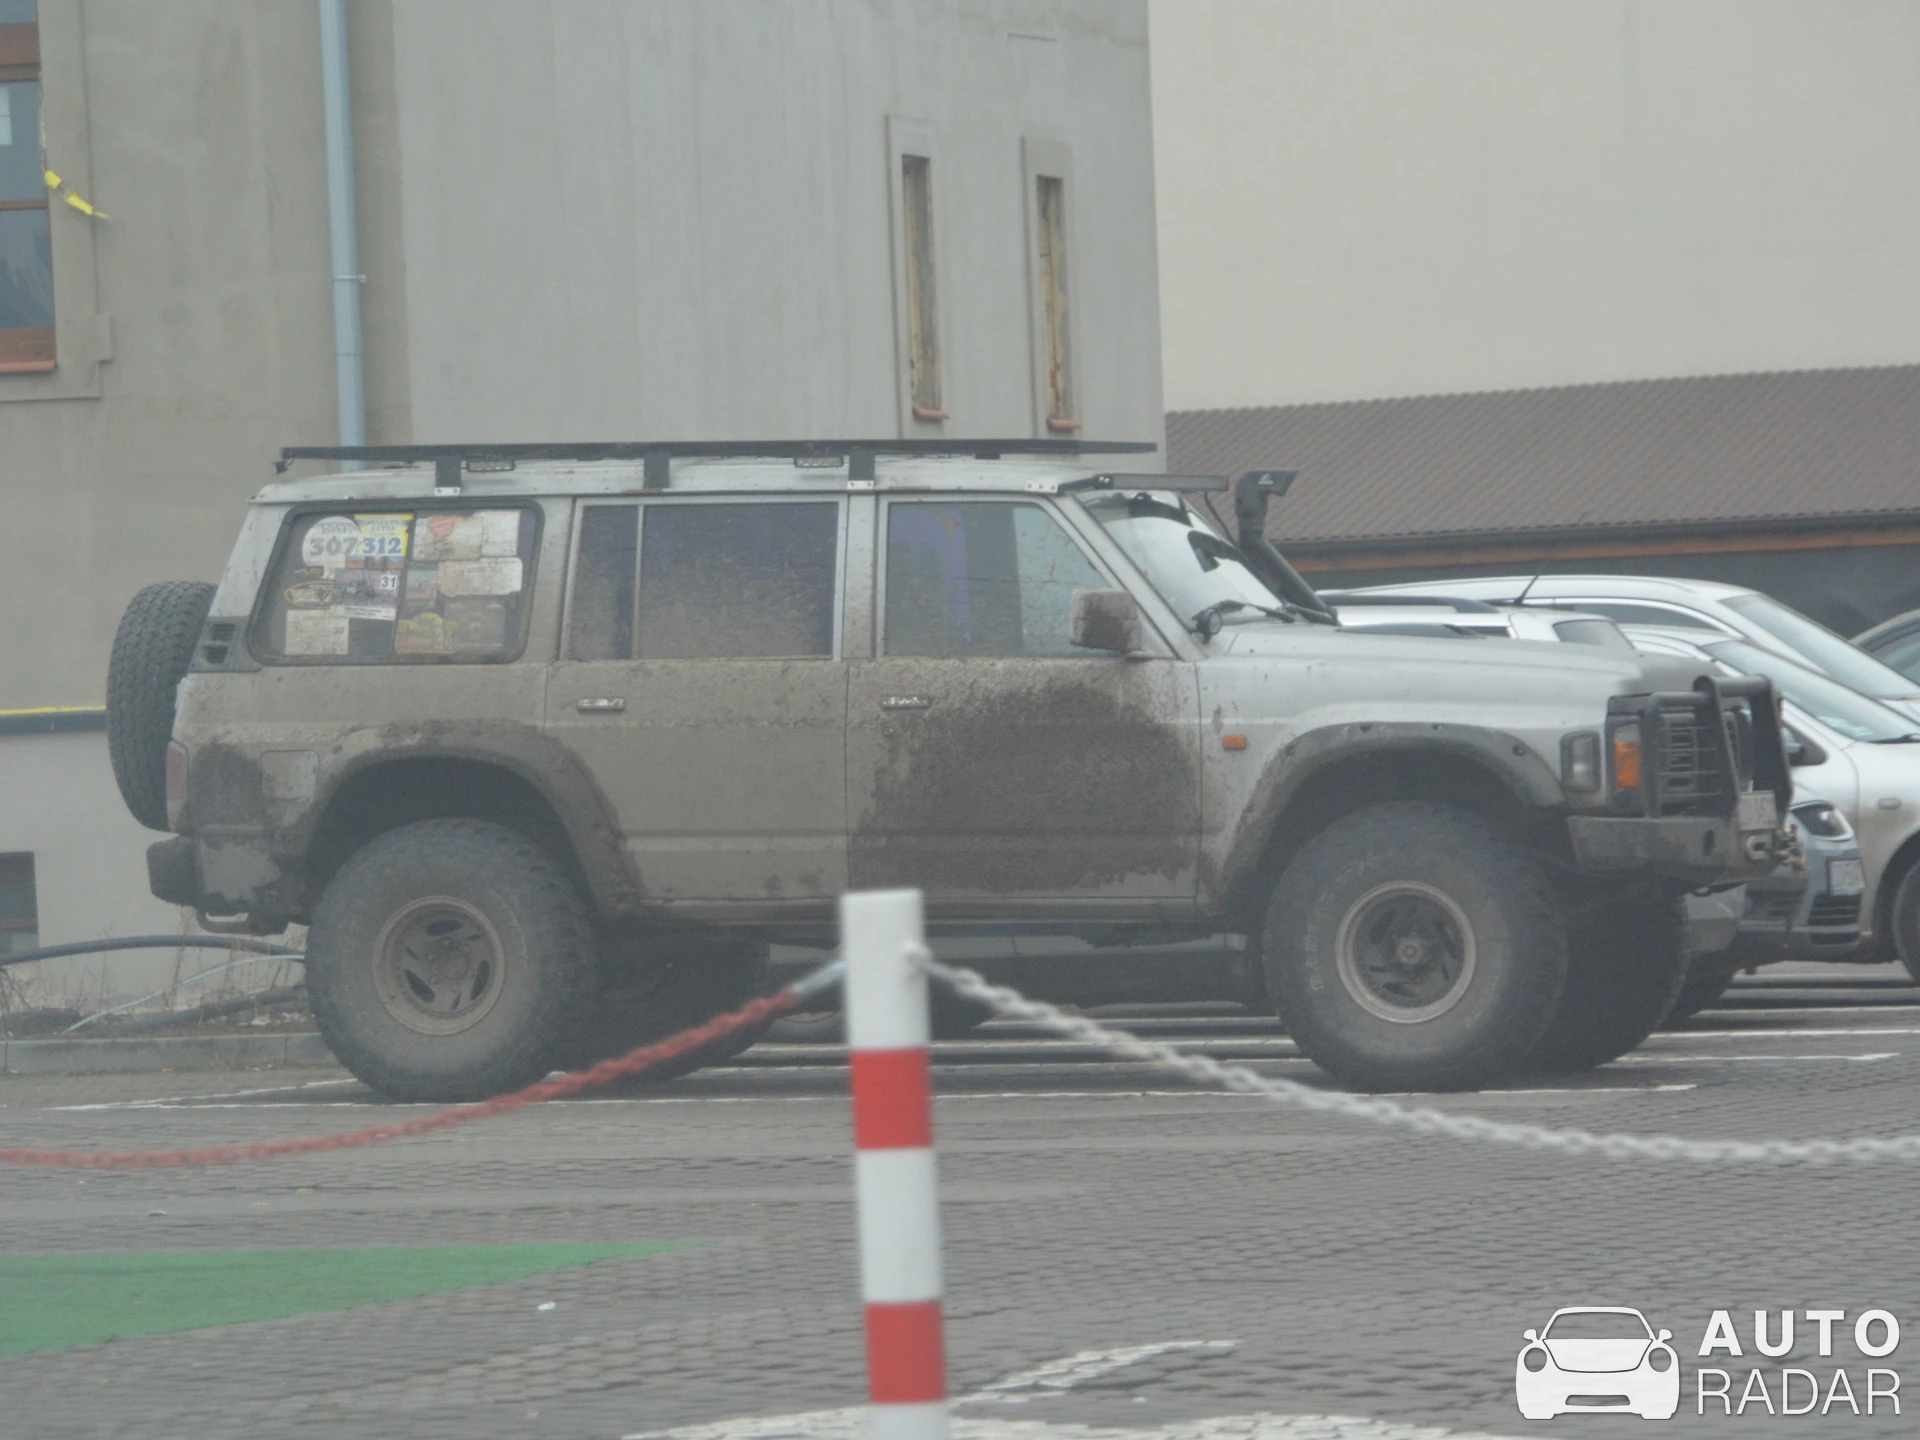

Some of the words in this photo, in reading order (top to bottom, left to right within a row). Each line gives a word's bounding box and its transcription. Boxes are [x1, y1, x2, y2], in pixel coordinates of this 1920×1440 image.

[310, 536, 358, 556] 307
[362, 536, 402, 554] 312
[381, 576, 396, 588] 31
